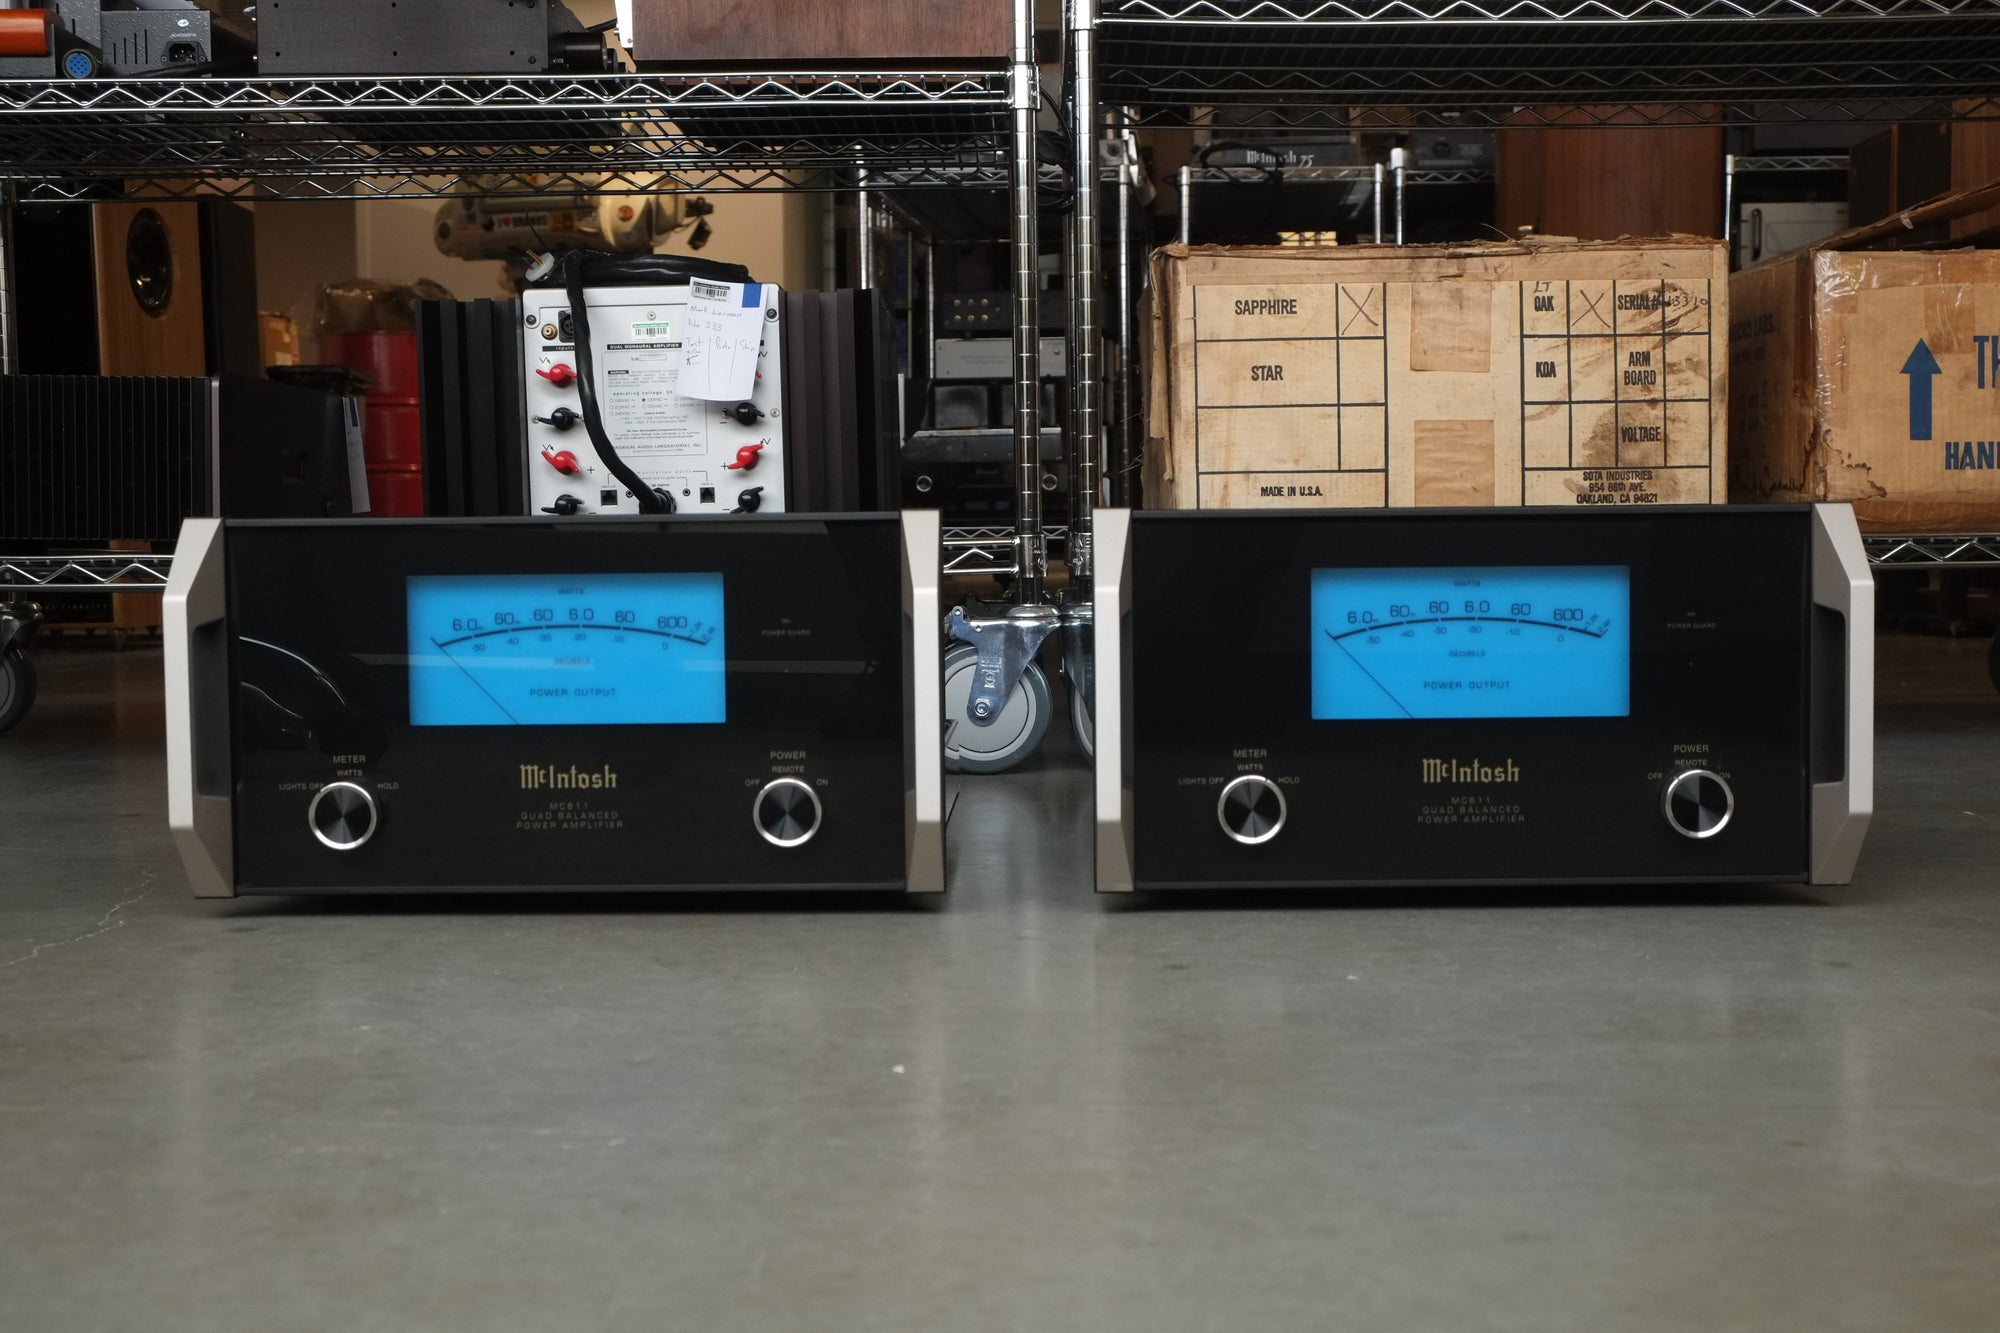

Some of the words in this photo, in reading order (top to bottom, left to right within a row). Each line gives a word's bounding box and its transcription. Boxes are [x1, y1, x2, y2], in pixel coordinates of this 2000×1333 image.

[1234, 298, 1298, 316] SAPPHIRE
[1534, 296, 1554, 312] OAK
[1628, 351, 1651, 367] ARM
[1251, 365, 1284, 381] STAR
[1536, 362, 1556, 377] KOA
[1624, 370, 1656, 385] BOARD
[1621, 427, 1661, 442] VOLTAGE
[1945, 442, 2000, 469] HAN
[1583, 471, 1602, 481] SOTA
[1606, 470, 1652, 481] INDUSTRIES
[1260, 486, 1284, 496] MADE
[1287, 486, 1296, 496] IN
[1629, 482, 1646, 492] AVE.
[1576, 493, 1616, 504] OAKLAND,
[1620, 493, 1631, 503] CA
[1464, 600, 1490, 613] 6.0
[1511, 603, 1531, 616] 60
[1553, 608, 1584, 621] 600
[568, 608, 594, 621] 6.0
[614, 610, 635, 623] 60
[657, 616, 688, 629] 600
[1557, 634, 1564, 642] 0
[662, 642, 669, 650] 0
[1423, 680, 1463, 690] POWER
[1468, 680, 1511, 690] OUTPUT
[529, 688, 569, 697] POWER
[574, 687, 616, 697] OUTPUT
[1233, 749, 1268, 758] METER
[1673, 744, 1709, 753] POWER
[332, 755, 367, 764] METER
[770, 751, 806, 760] POWER
[1236, 763, 1264, 771] WATTS
[1674, 759, 1708, 767] REMOTE
[336, 769, 363, 777] WATTS
[771, 766, 805, 774] REMOTE
[1422, 758, 1521, 783] McIntosh
[520, 764, 618, 789] McIntosh
[1178, 777, 1207, 785] LIGHTS
[1278, 776, 1300, 784] HOLD
[279, 782, 307, 790] LIGHTS
[309, 782, 324, 790] OFF
[377, 782, 399, 790] HOLD
[744, 778, 760, 786] OFF
[815, 778, 829, 786] ON
[1422, 806, 1454, 815] QUAD
[1460, 805, 1521, 814] BALANCED
[521, 812, 552, 821] QUAD
[558, 811, 619, 820] BALANCED
[1417, 816, 1458, 824] POWER
[1463, 815, 1526, 823] AMPLIFIER
[516, 822, 556, 830] POWER
[562, 821, 624, 830] AMPLIFIER
